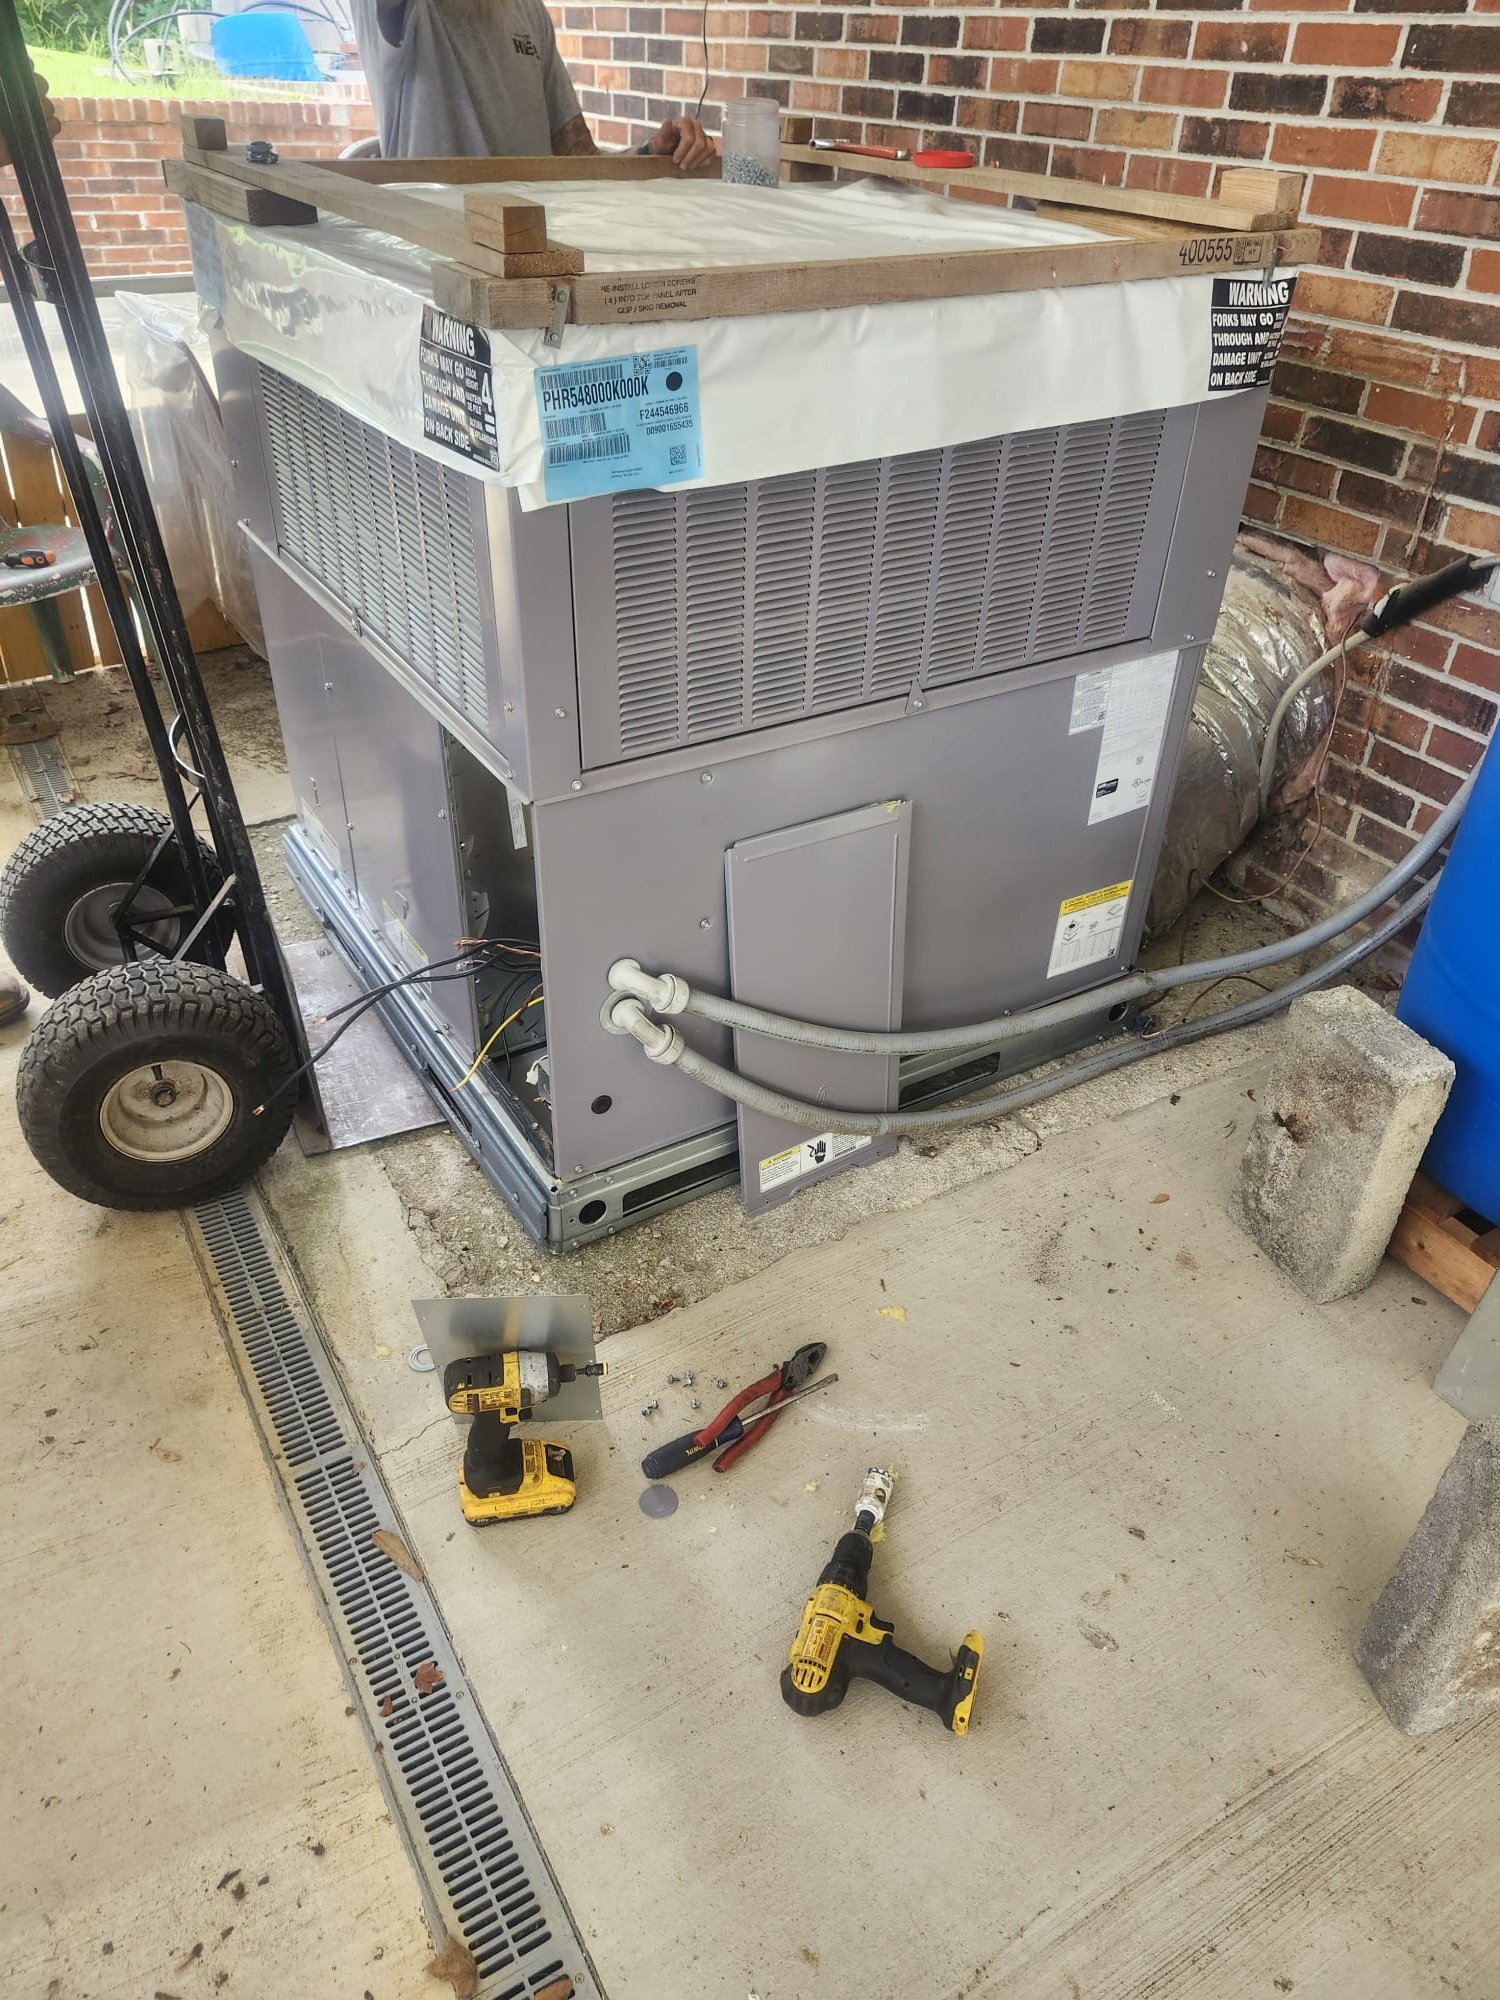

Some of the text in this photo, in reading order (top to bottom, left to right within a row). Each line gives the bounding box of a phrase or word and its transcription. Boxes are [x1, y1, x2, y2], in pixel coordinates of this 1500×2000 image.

[1179, 239, 1233, 266] 400555
[618, 294, 635, 303] INTO
[655, 300, 688, 310] REMOVAL
[1229, 281, 1289, 306] WARNING
[1212, 313, 1239, 327] FORKS
[1240, 313, 1256, 327] MAY
[1260, 312, 1273, 326] GO
[431, 311, 476, 358] WARNING
[1213, 332, 1253, 346] THROUGH
[1254, 332, 1270, 346] AND
[420, 345, 465, 380] FORKS MAY GO
[1213, 352, 1246, 366] DAMAGE
[421, 370, 466, 406] THROUGH AND
[1210, 372, 1223, 386] ON
[1224, 371, 1245, 385] BACK
[481, 372, 493, 413] 4
[542, 375, 650, 412] PHR548000K000K
[423, 392, 450, 419] DAMAGE
[639, 402, 689, 421] F244546966
[424, 416, 435, 432] ON
[436, 421, 453, 443] BACK
[646, 419, 694, 436] 009001655435
